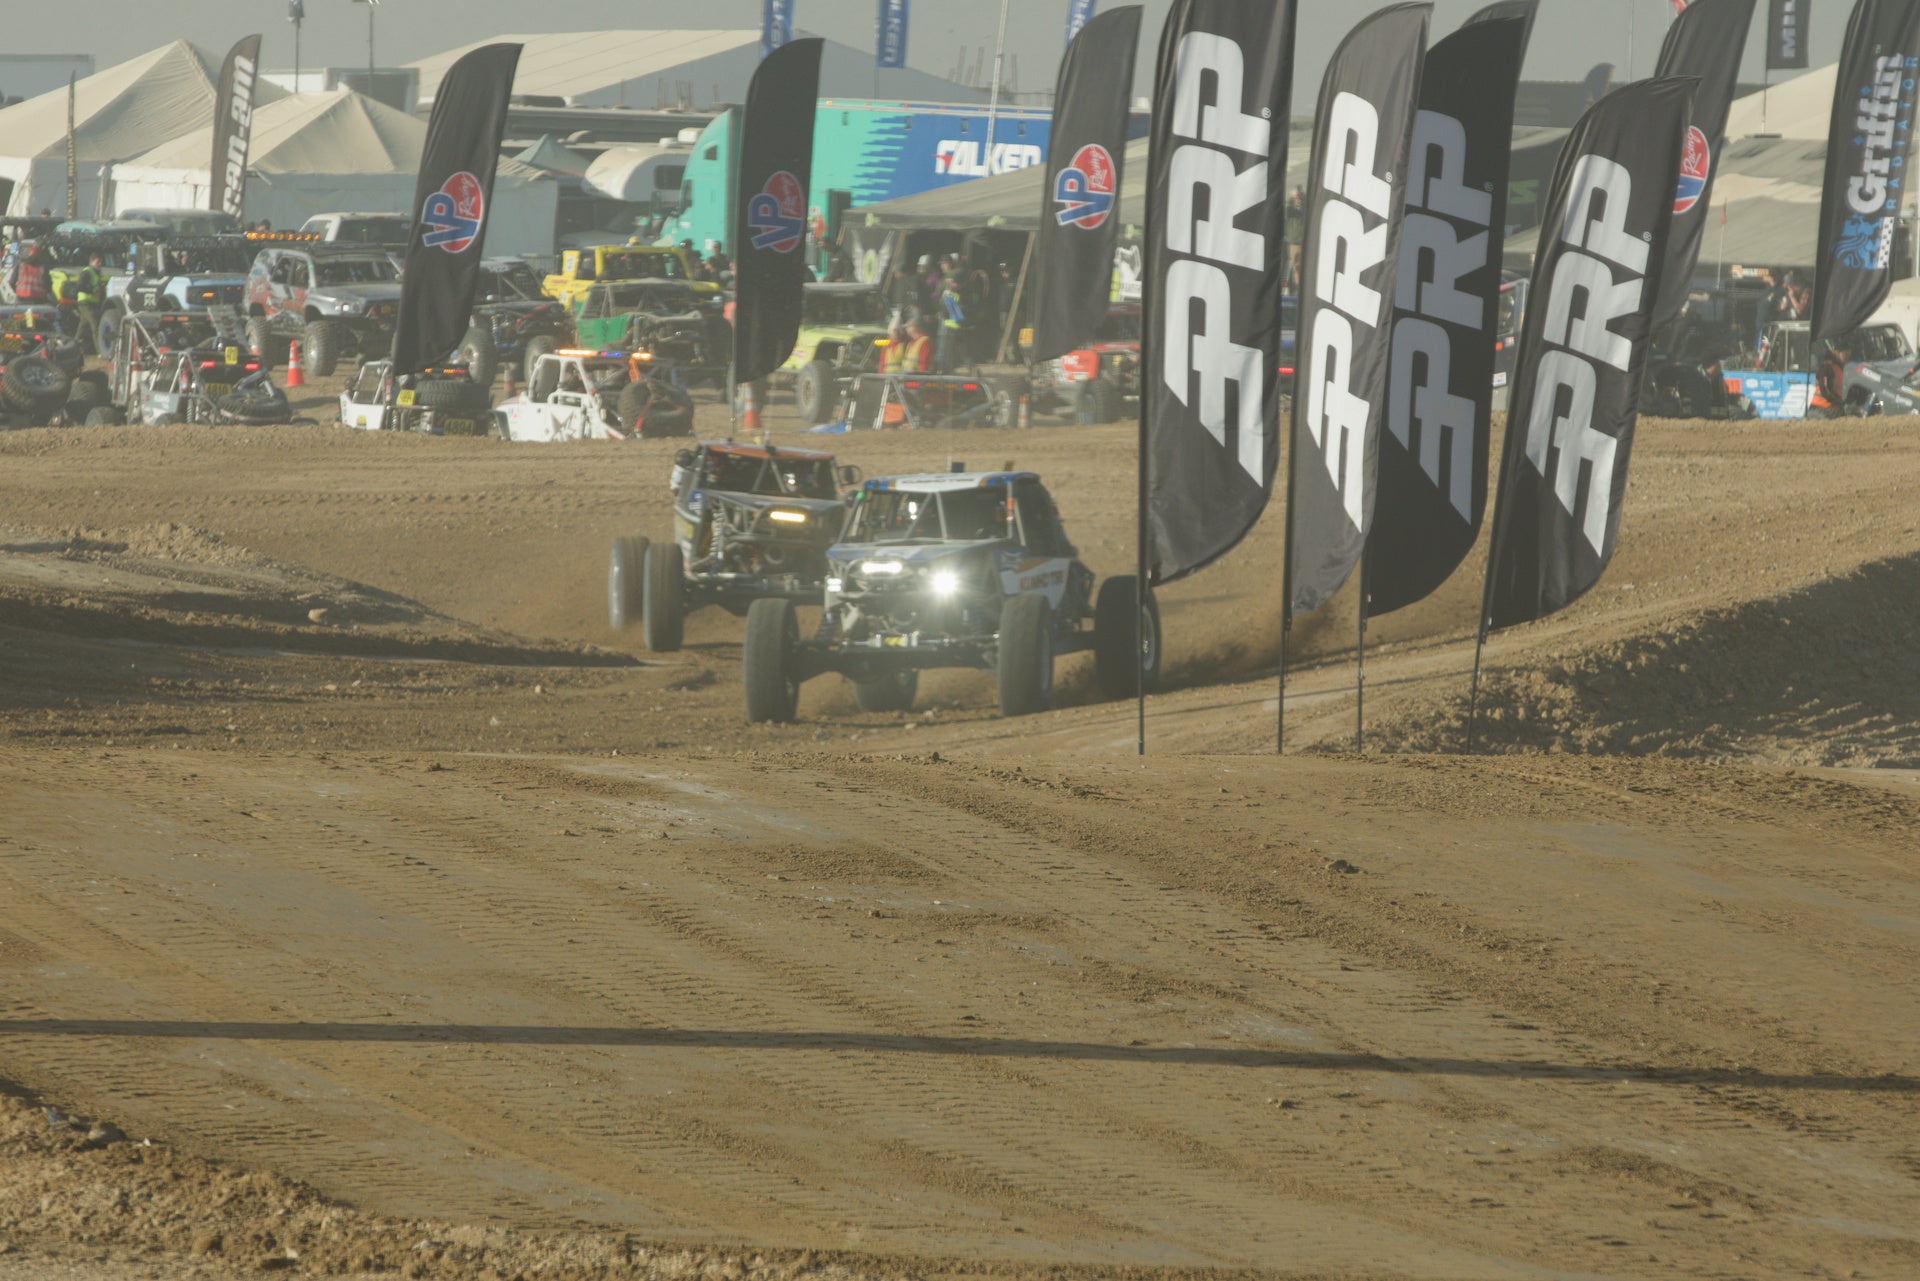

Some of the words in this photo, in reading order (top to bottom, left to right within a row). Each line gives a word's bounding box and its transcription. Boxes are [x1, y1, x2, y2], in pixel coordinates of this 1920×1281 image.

[935, 140, 1041, 177] FALKEN
[1053, 167, 1115, 226] VP
[1683, 128, 1702, 175] Racing
[1848, 53, 1904, 214] Griffin
[1885, 56, 1918, 210] RADIATOR
[421, 191, 481, 247] VP
[747, 193, 804, 249] VP
[1164, 30, 1271, 488] PRP
[1306, 90, 1392, 533] PRP
[1388, 109, 1493, 526] PRP
[1524, 154, 1652, 559] PRP
